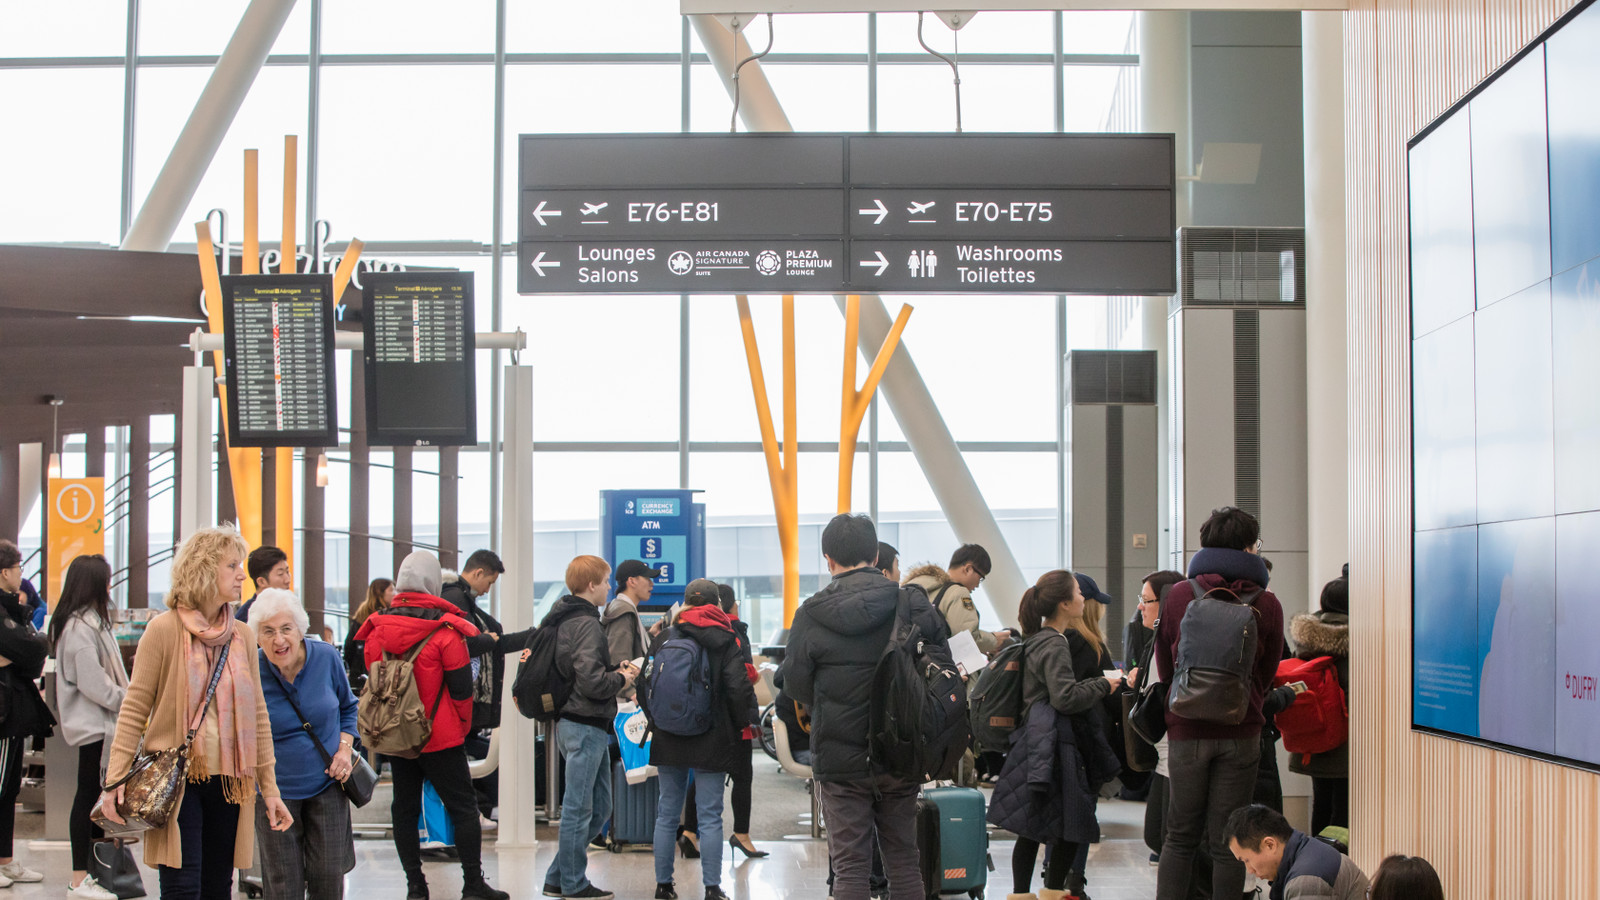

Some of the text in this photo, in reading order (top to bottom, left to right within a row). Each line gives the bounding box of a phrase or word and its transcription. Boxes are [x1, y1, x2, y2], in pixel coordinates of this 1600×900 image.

[627, 202, 719, 222] E76-E81
[955, 202, 1053, 222] E70-E75
[578, 246, 656, 264] Lounges
[695, 257, 744, 265] SIGNATURE
[786, 250, 819, 259] PLAZA
[956, 245, 1063, 261] Washrooms
[786, 259, 833, 268] PREMIUM
[578, 267, 639, 283] Salons
[957, 267, 1036, 283] Toilettes
[641, 521, 660, 529] ATM
[1571, 674, 1598, 701] DUFRY
